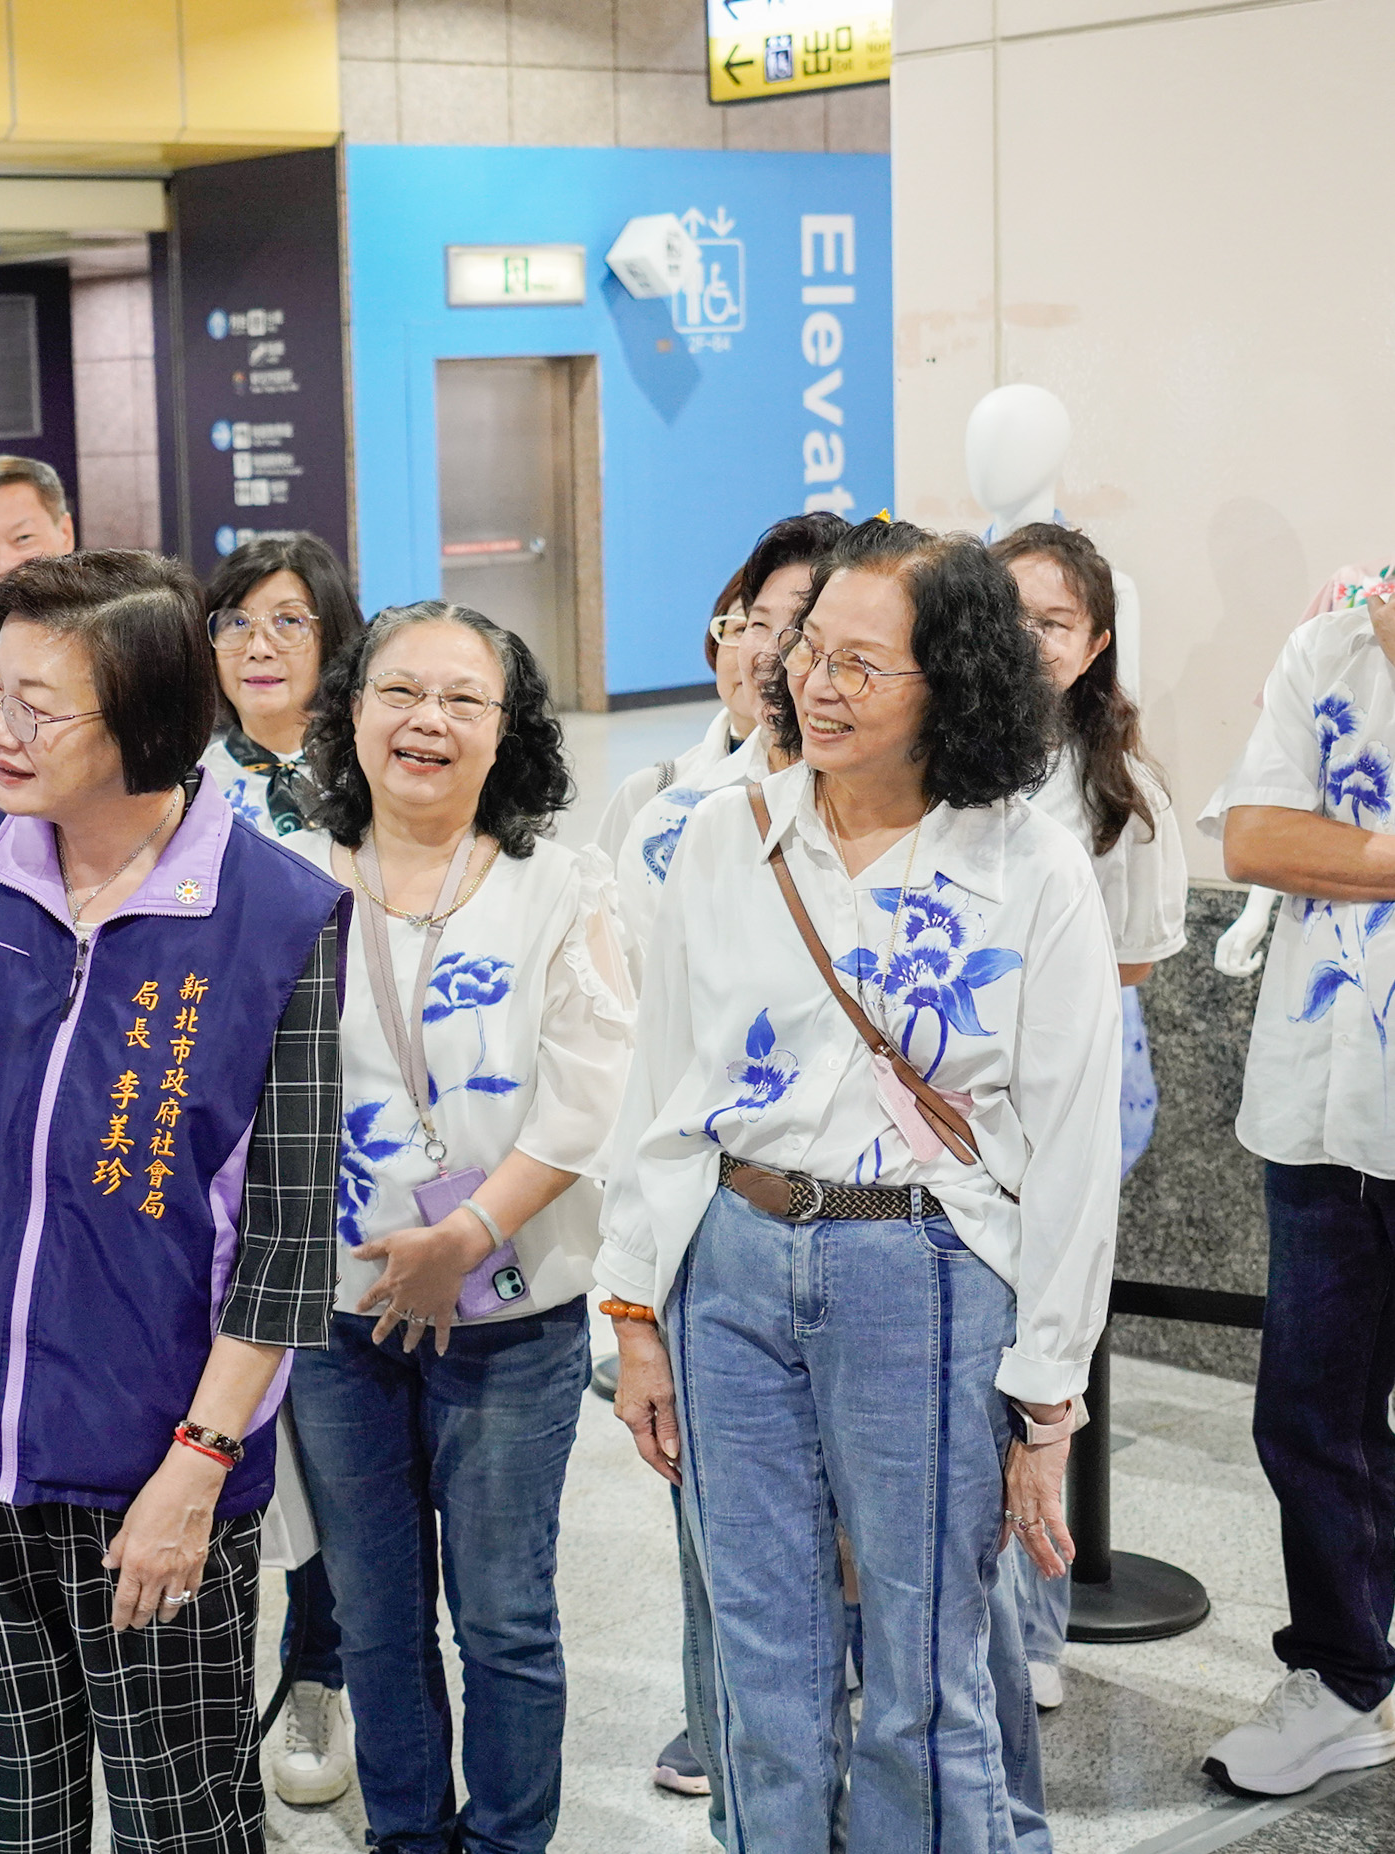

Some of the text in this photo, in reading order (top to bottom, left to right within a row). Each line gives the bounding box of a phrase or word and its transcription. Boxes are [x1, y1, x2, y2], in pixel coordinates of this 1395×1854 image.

[803, 26, 852, 76] 出口
[91, 980, 160, 1196] 局長 李美珍
[138, 972, 210, 1220] 新北市政府社會局
